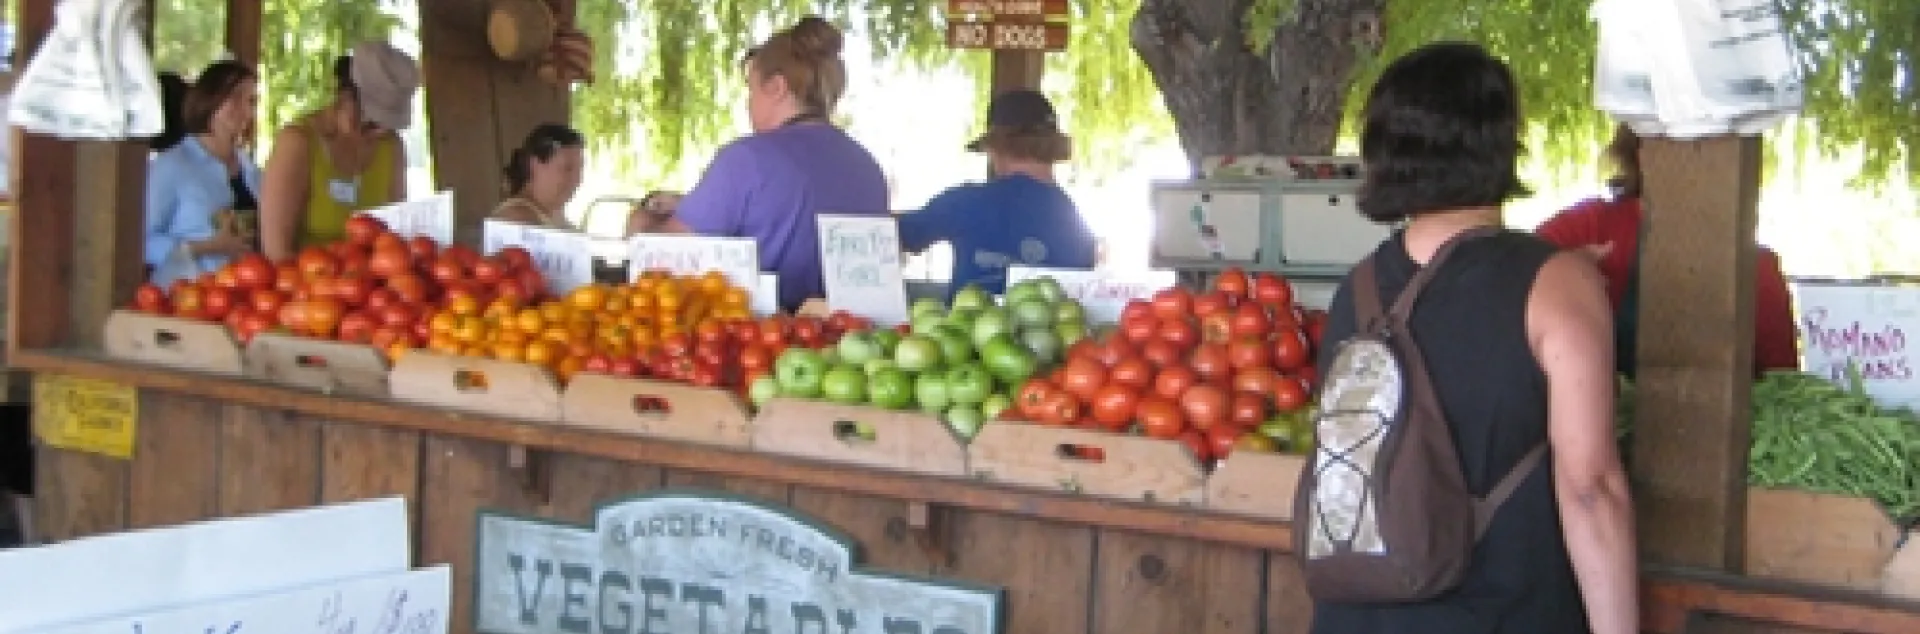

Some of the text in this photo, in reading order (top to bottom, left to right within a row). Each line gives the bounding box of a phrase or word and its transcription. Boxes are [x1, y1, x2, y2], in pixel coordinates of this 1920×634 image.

[955, 24, 1045, 49] NO DOGS
[1804, 306, 1906, 357] ROMANO
[610, 515, 839, 582] GARDEN FRESH
[507, 553, 971, 634] VEGETA
